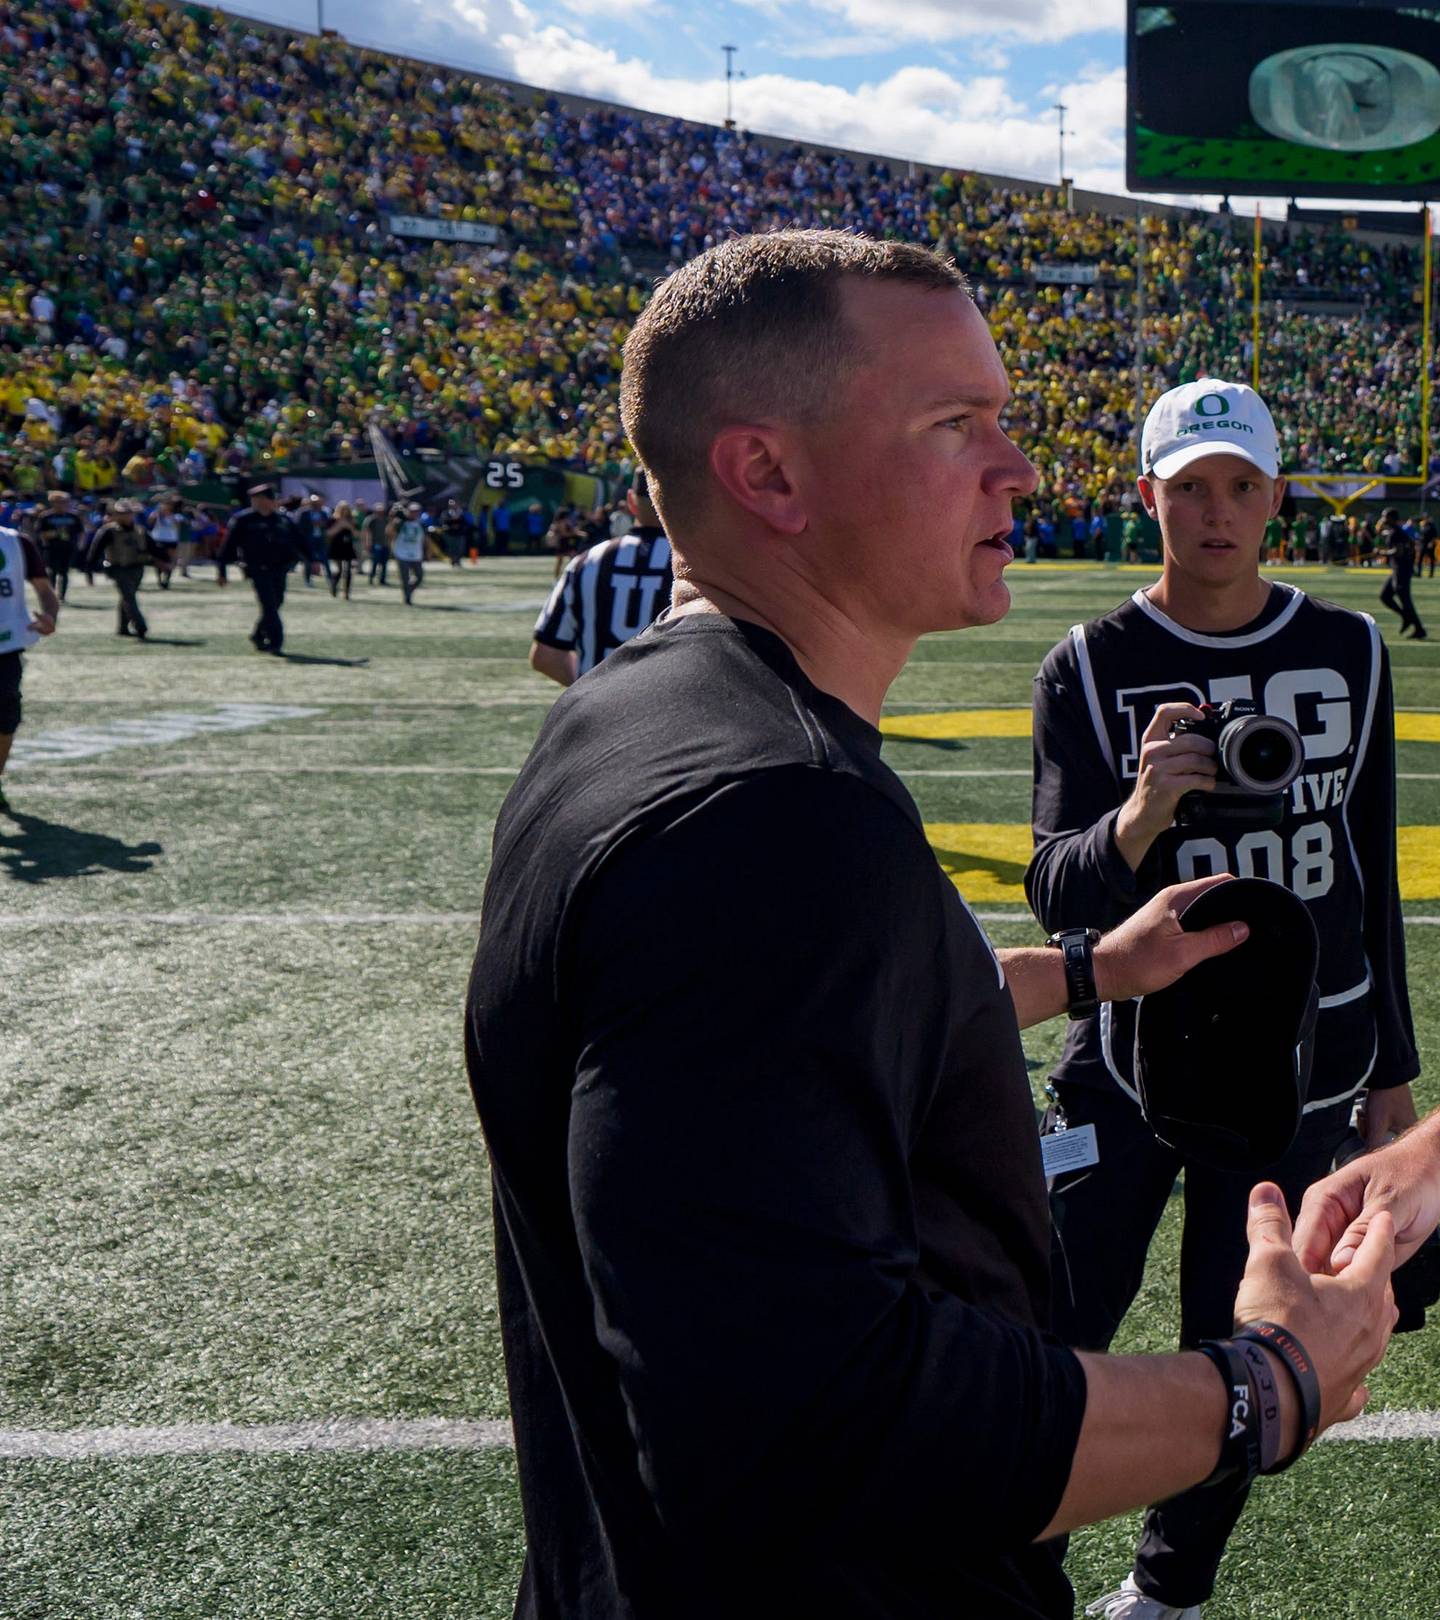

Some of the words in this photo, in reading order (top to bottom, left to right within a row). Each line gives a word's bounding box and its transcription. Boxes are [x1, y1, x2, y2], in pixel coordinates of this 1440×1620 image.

[1176, 420, 1254, 437] OREGON
[486, 461, 524, 488] 25
[610, 572, 663, 643] U
[1228, 1383, 1250, 1440] FCA
